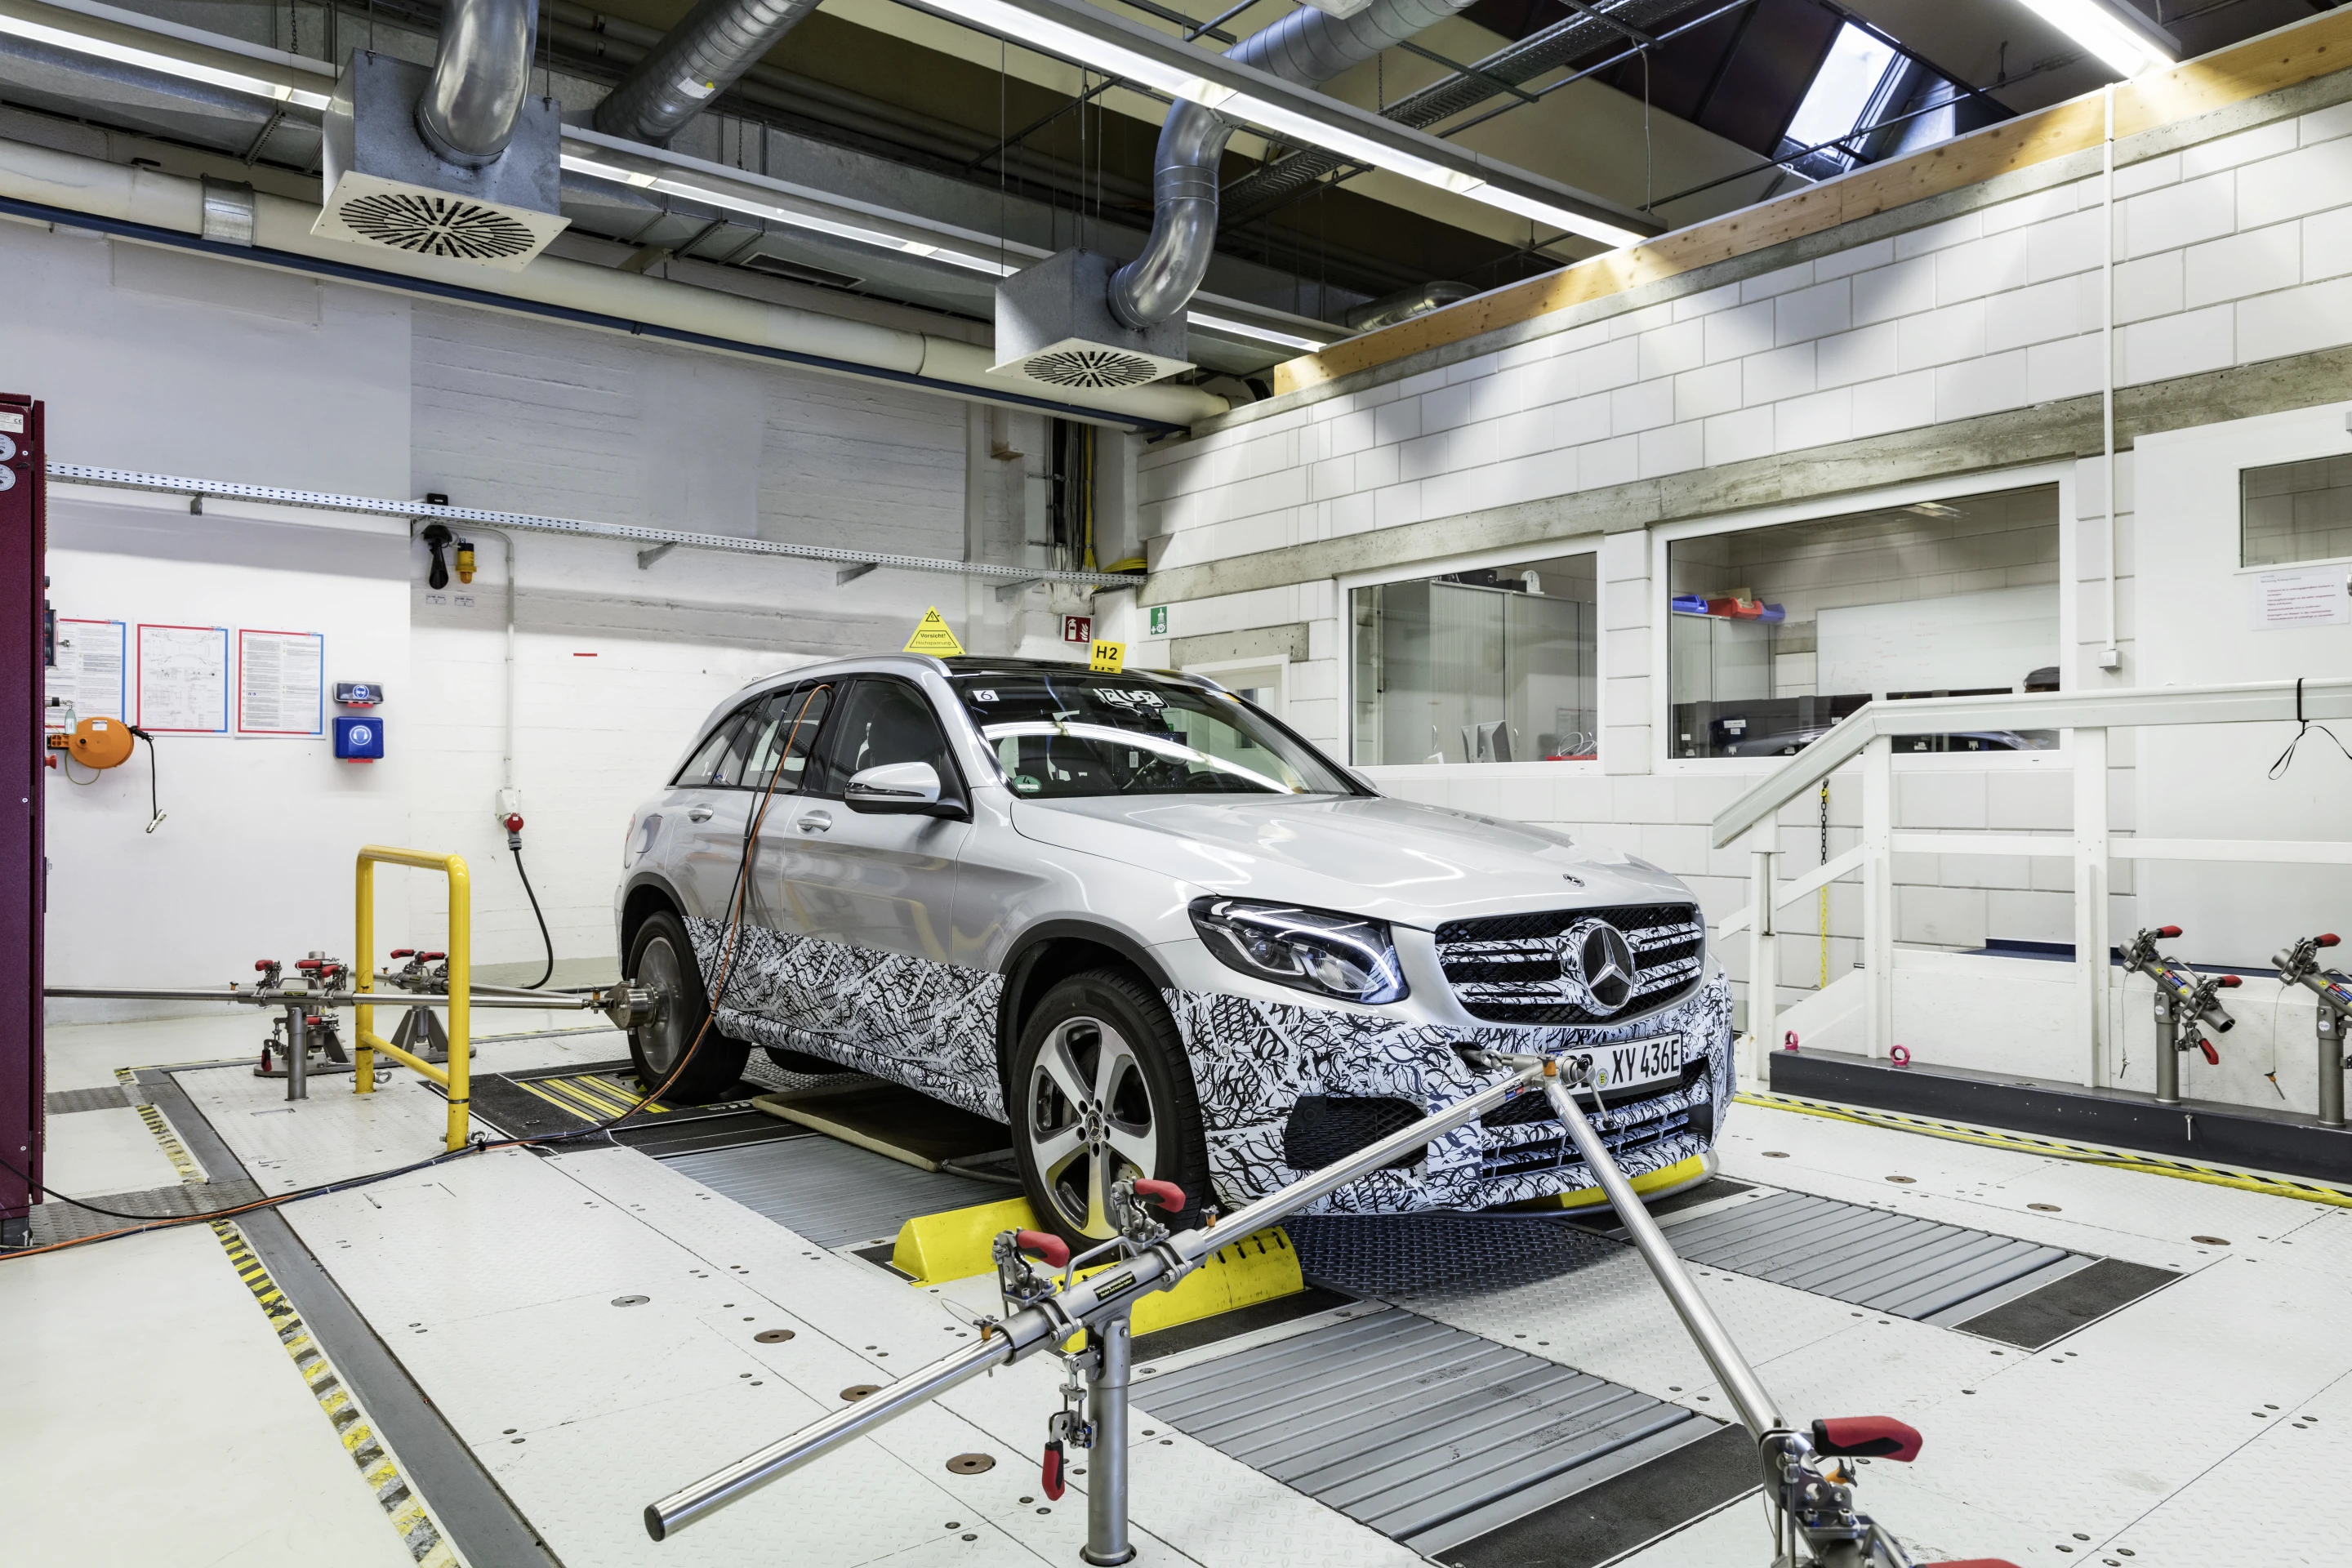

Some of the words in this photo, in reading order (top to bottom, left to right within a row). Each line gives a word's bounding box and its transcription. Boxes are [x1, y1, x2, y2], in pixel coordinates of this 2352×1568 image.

[1095, 645, 1118, 661] H2
[980, 690, 993, 701] 6
[1611, 1047, 1637, 1085] XY
[1640, 1039, 1680, 1079] 436E
